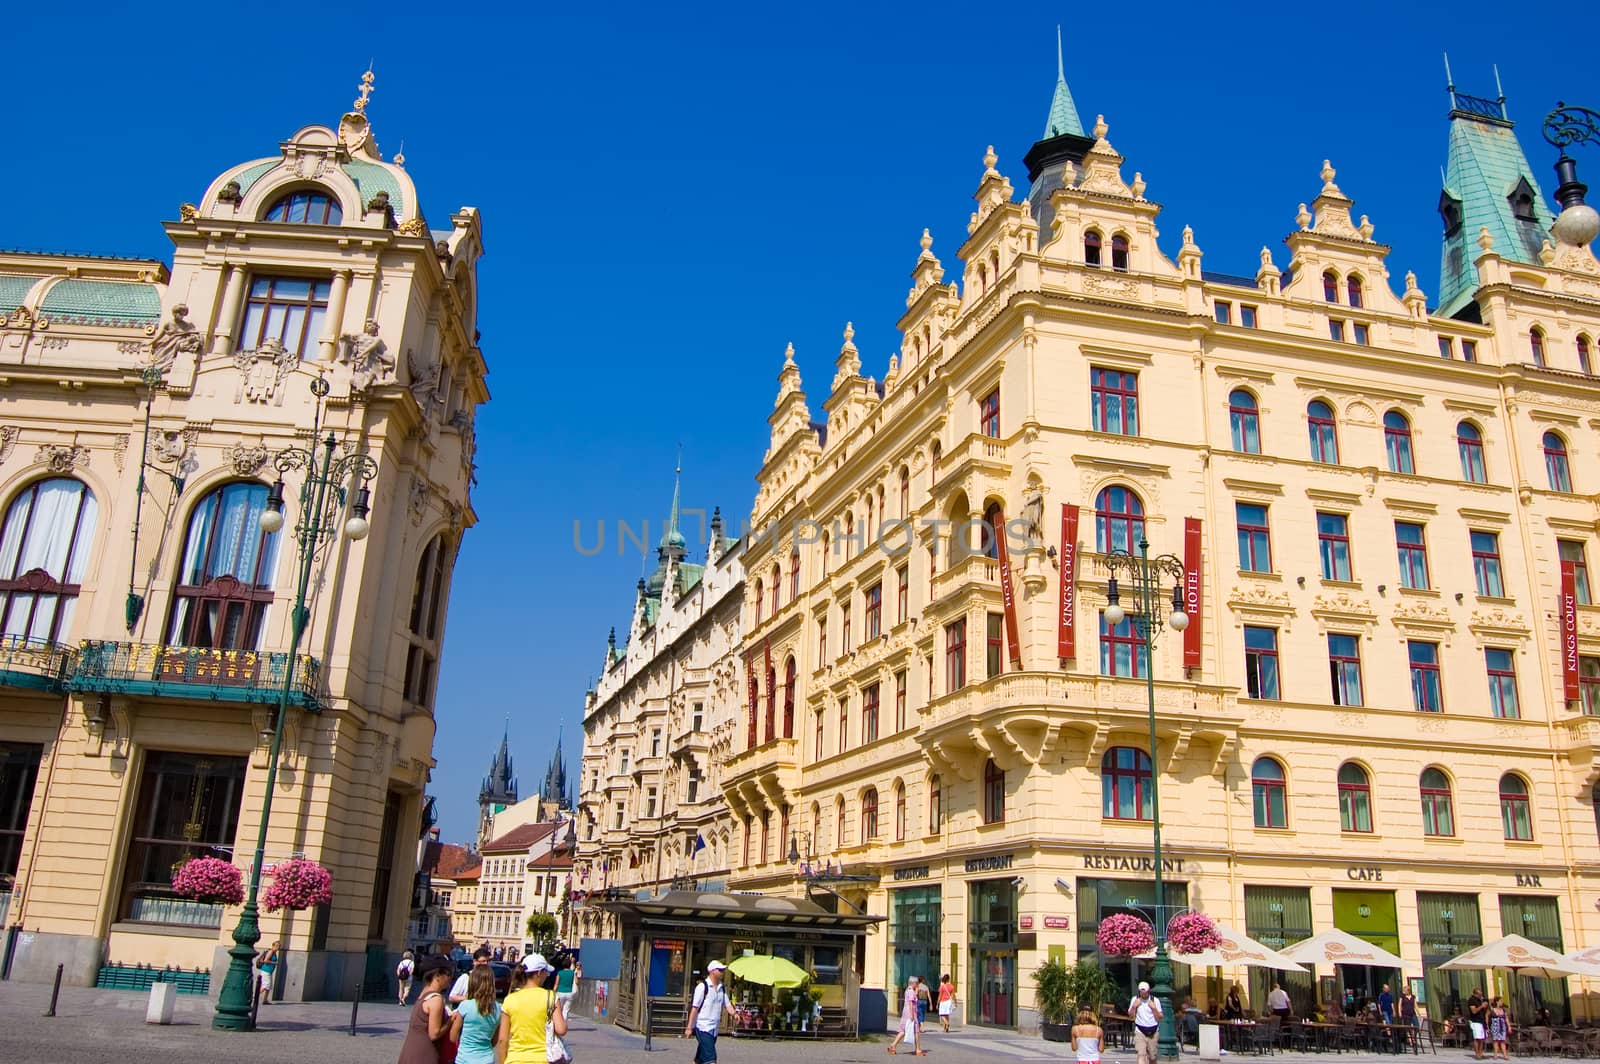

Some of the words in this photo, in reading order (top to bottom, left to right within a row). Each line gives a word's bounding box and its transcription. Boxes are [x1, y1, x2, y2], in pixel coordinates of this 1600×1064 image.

[1064, 543, 1073, 583] COURT
[1063, 586, 1072, 627] KINGS
[1188, 568, 1198, 614] HOTEL
[1565, 593, 1575, 631] COURT
[1567, 635, 1576, 671] KINGS
[1347, 867, 1383, 882] CAFE
[1516, 873, 1542, 888] BAR
